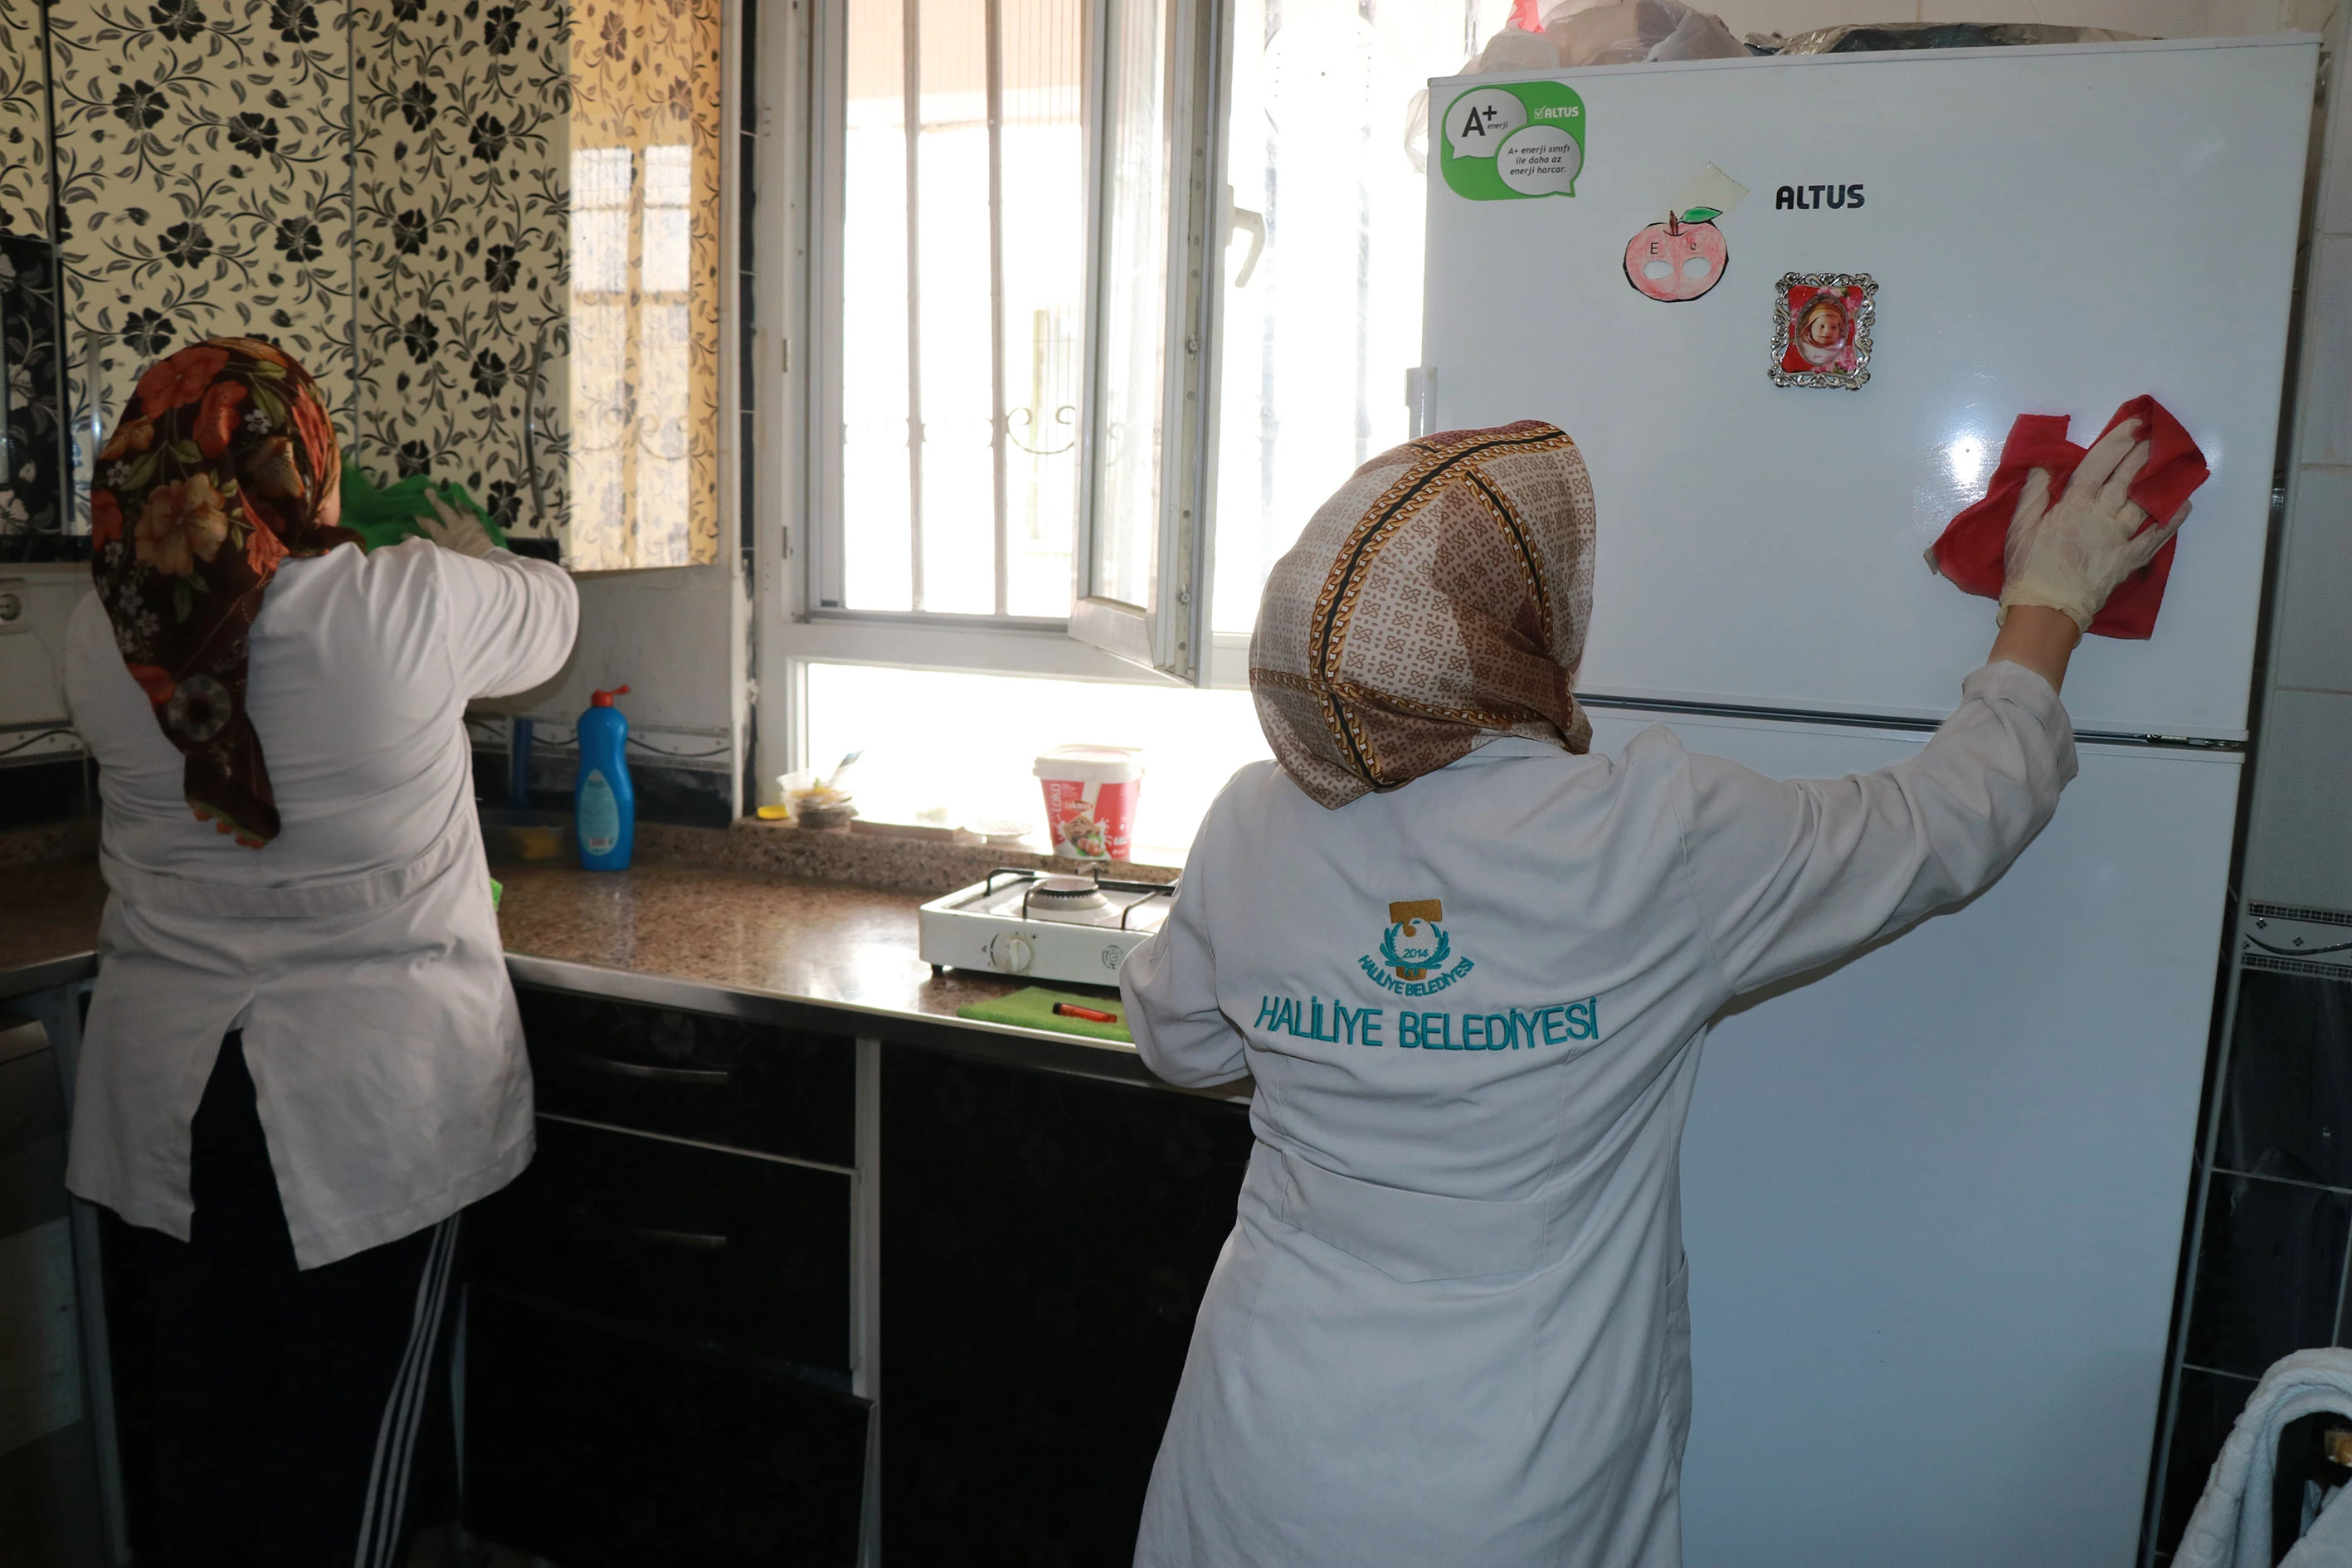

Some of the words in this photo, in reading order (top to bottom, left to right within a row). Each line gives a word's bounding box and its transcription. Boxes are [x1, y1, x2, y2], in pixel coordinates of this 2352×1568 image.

[1544, 106, 1580, 119] ALTUS
[1462, 105, 1497, 138] A+
[1488, 121, 1508, 130] enerji
[1522, 144, 1546, 155] enerji
[1548, 144, 1570, 153] sınıfı
[1528, 156, 1549, 164] daha
[1510, 167, 1535, 176] enerji
[1536, 166, 1566, 174] harcar.
[1775, 184, 1865, 210] ALTUS
[1650, 241, 1659, 255] E
[1402, 948, 1429, 959] 2014
[1254, 996, 1383, 1046] HALİLİYE
[1400, 996, 1599, 1050] BELEDİYESİ
